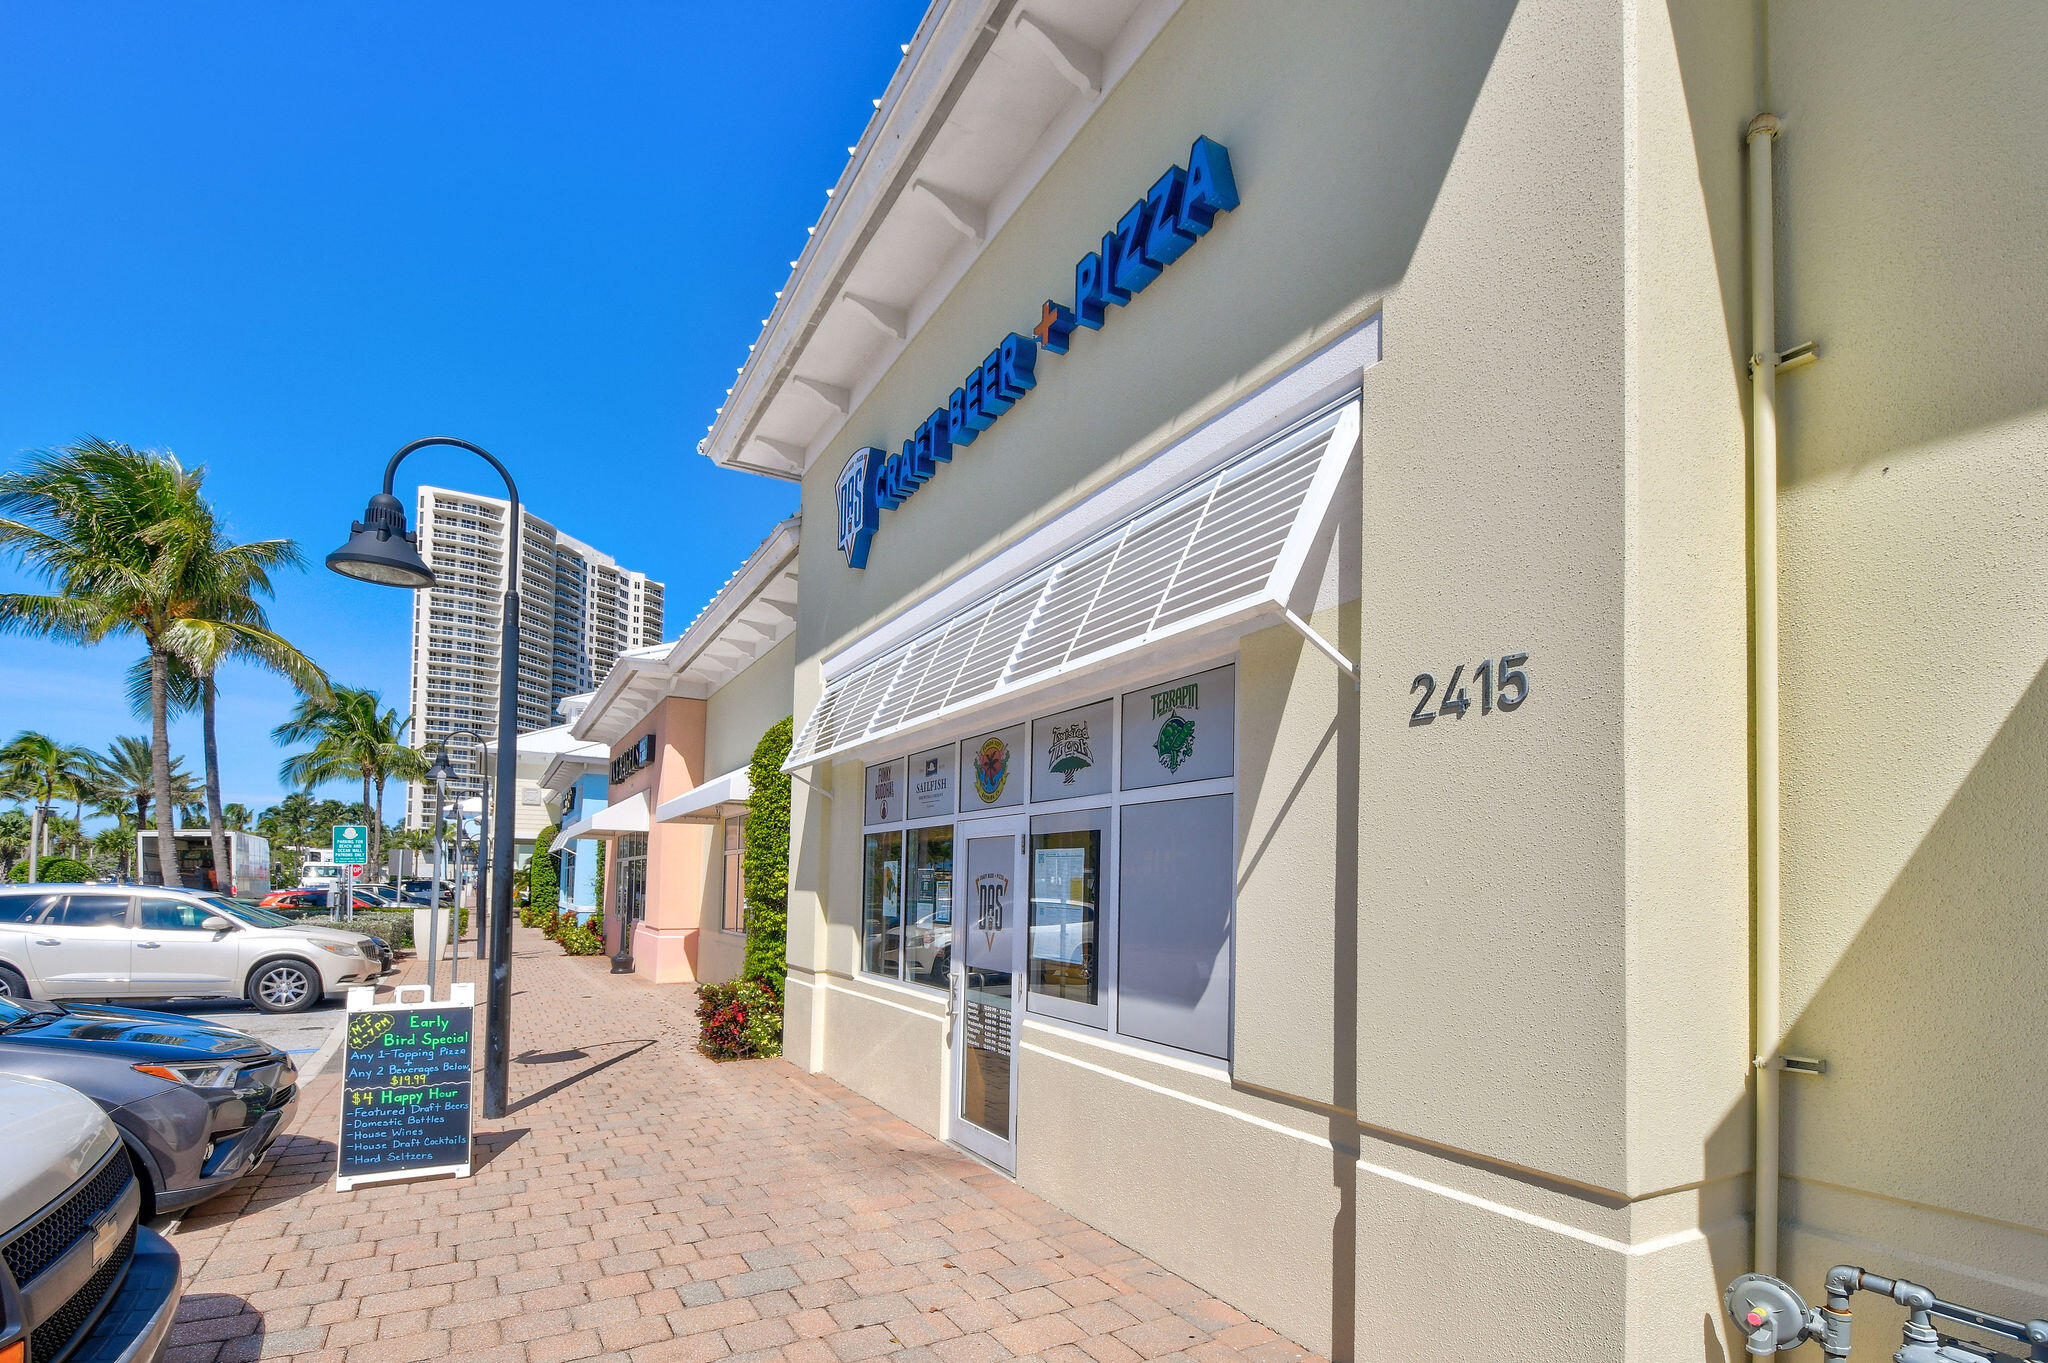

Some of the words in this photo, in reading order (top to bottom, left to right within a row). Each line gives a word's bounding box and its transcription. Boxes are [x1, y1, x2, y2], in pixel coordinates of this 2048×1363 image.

[876, 407, 952, 510] CRAFT
[949, 332, 1037, 446] BEER
[1074, 134, 1240, 330] PIZZA
[840, 467, 863, 543] DAS
[1410, 652, 1529, 722] 2415
[1151, 682, 1200, 720] TERRAPIN
[915, 778, 948, 793] SAILFISH
[979, 885, 1003, 931] DAS
[351, 1015, 372, 1035] M-F
[410, 1015, 449, 1032] Early
[384, 1033, 416, 1046] Bird
[421, 1032, 469, 1050] Special
[350, 1051, 374, 1063] Any
[377, 1048, 434, 1061] 1-Topping
[439, 1047, 466, 1056] Pizza
[348, 1067, 372, 1080] Any
[376, 1067, 384, 1076] 2
[389, 1064, 439, 1076] Beverages
[389, 1074, 427, 1086] $19.99
[352, 1091, 373, 1106] $4
[380, 1090, 423, 1106] Happy
[428, 1088, 459, 1100] Hour
[411, 1103, 442, 1114] Draft
[444, 1101, 469, 1110] Beers
[407, 1115, 445, 1125] Bottles
[392, 1128, 424, 1137] Wines
[393, 1139, 421, 1149] Draft
[424, 1135, 466, 1146] Cocktails
[387, 1151, 433, 1162] Seltzers
